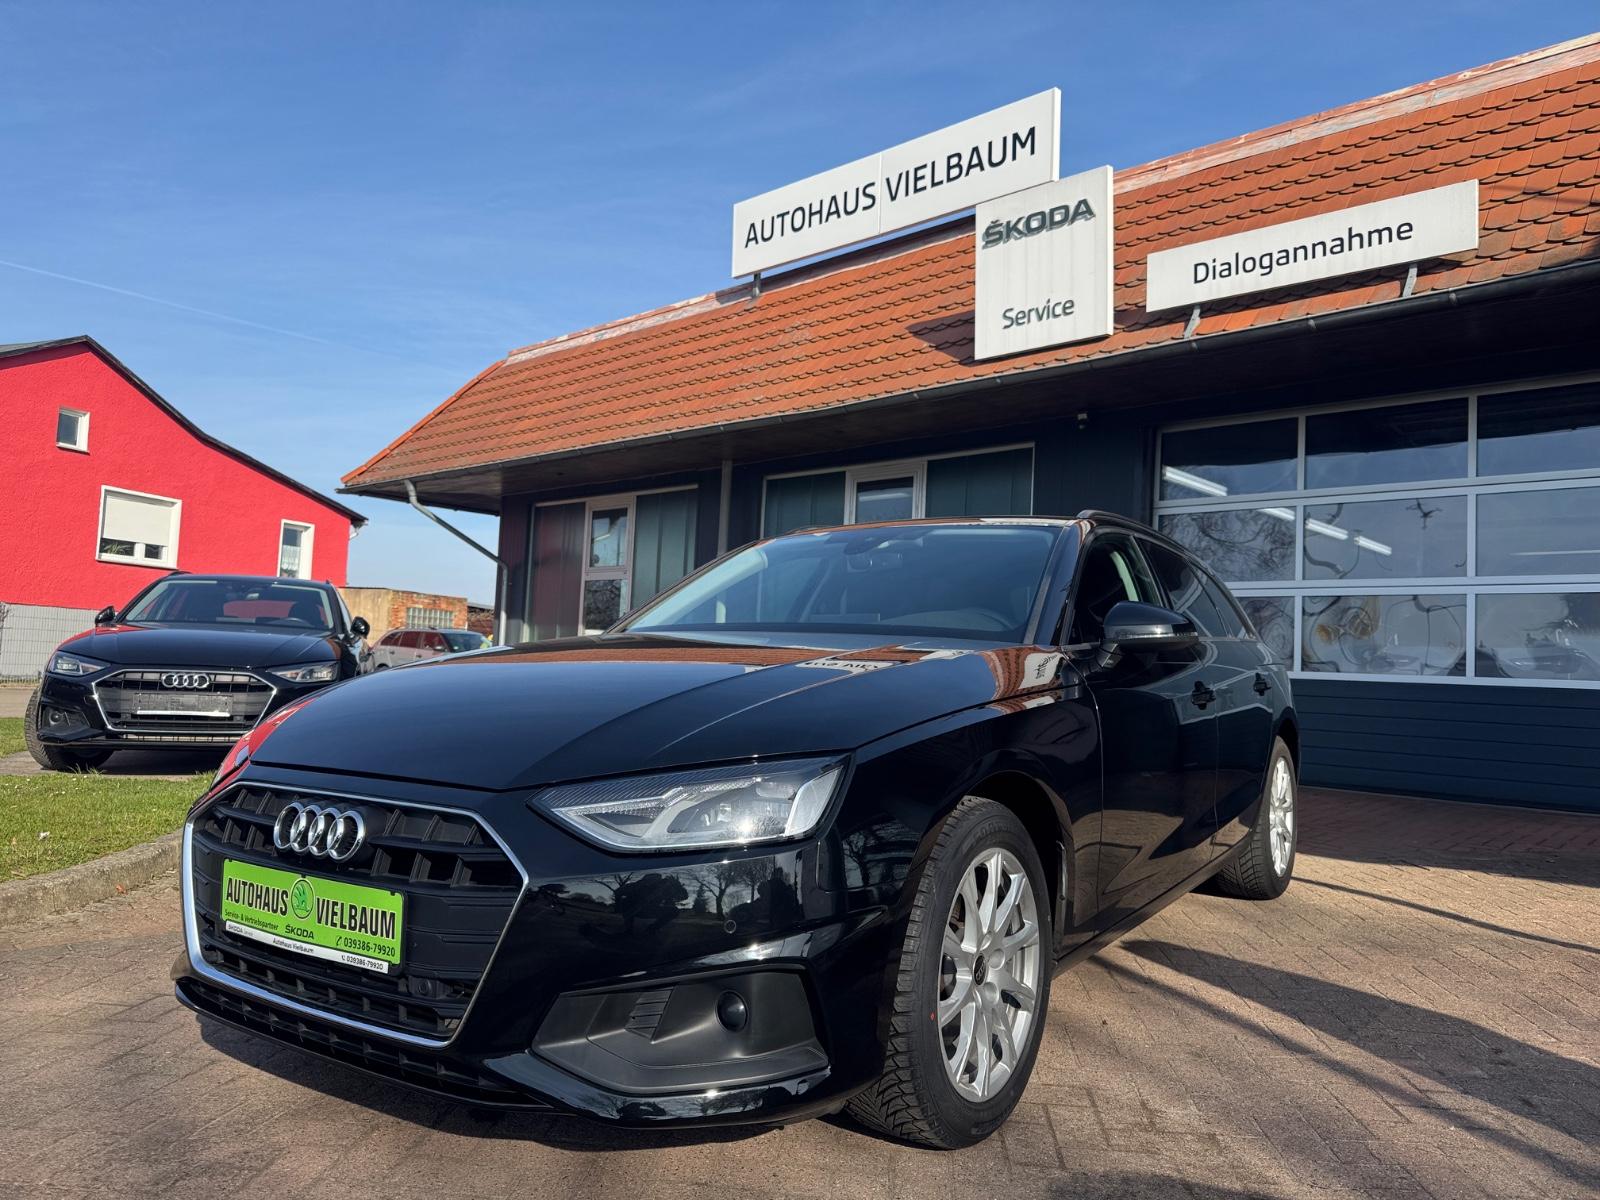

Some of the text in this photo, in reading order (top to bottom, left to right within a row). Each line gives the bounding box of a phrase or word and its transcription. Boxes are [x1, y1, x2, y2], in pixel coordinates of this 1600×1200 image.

[744, 126, 1036, 249] AUTOHAUS VIELBAUM
[981, 198, 1096, 250] ŠKODA
[1193, 221, 1413, 285] Dialogannahme
[1002, 297, 1075, 330] Service
[226, 877, 396, 940] AUTOHAUS VIELBAUM
[285, 924, 314, 939] ŠKODA
[344, 936, 396, 957] 039386-79920
